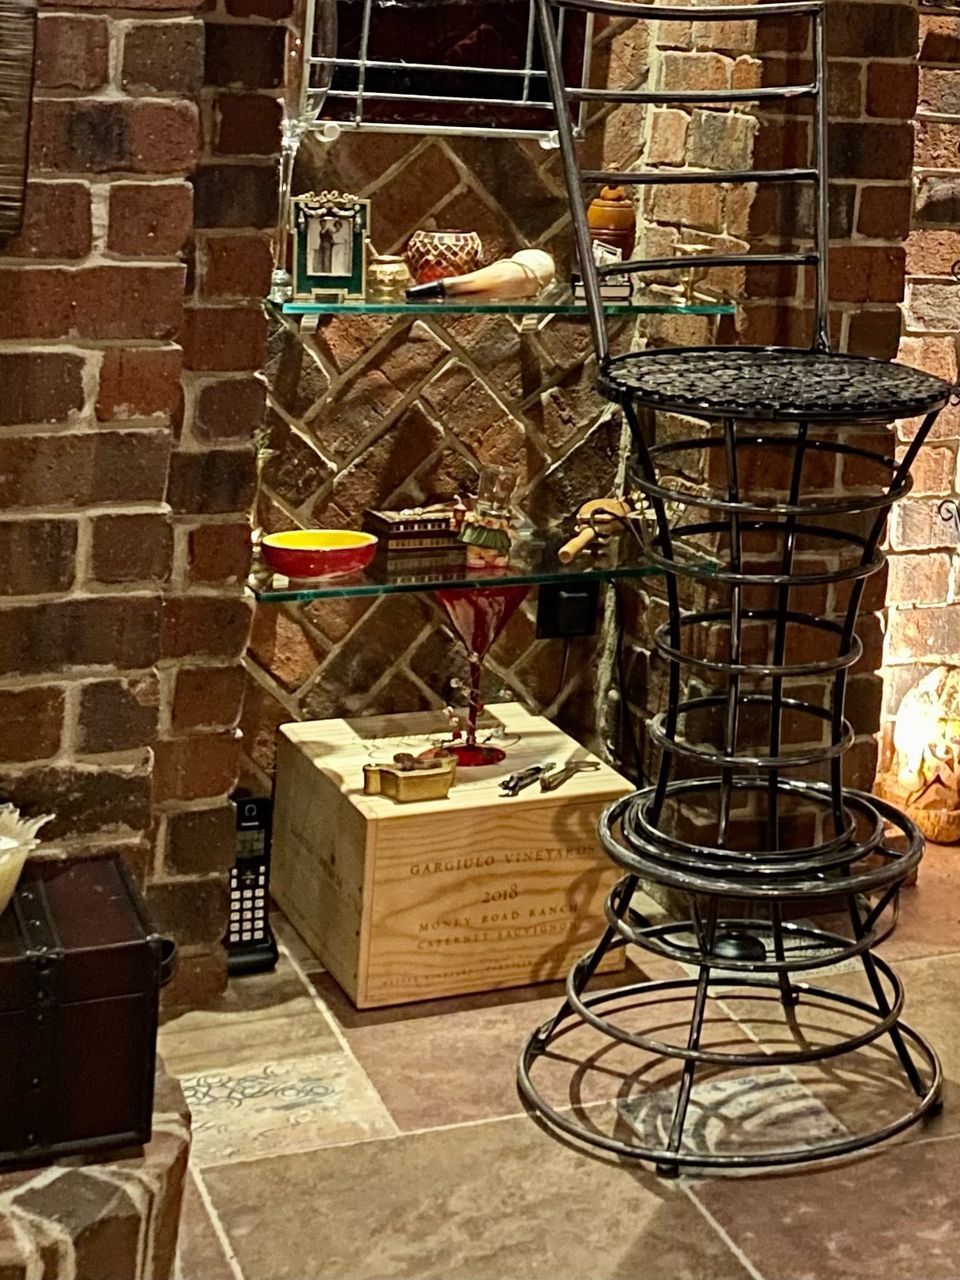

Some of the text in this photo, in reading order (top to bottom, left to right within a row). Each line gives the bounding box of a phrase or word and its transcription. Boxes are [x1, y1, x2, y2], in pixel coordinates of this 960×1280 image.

[410, 845, 597, 876] GARGIULO VINEYARDS
[481, 883, 520, 903] 2018
[418, 916, 471, 933] MONEY
